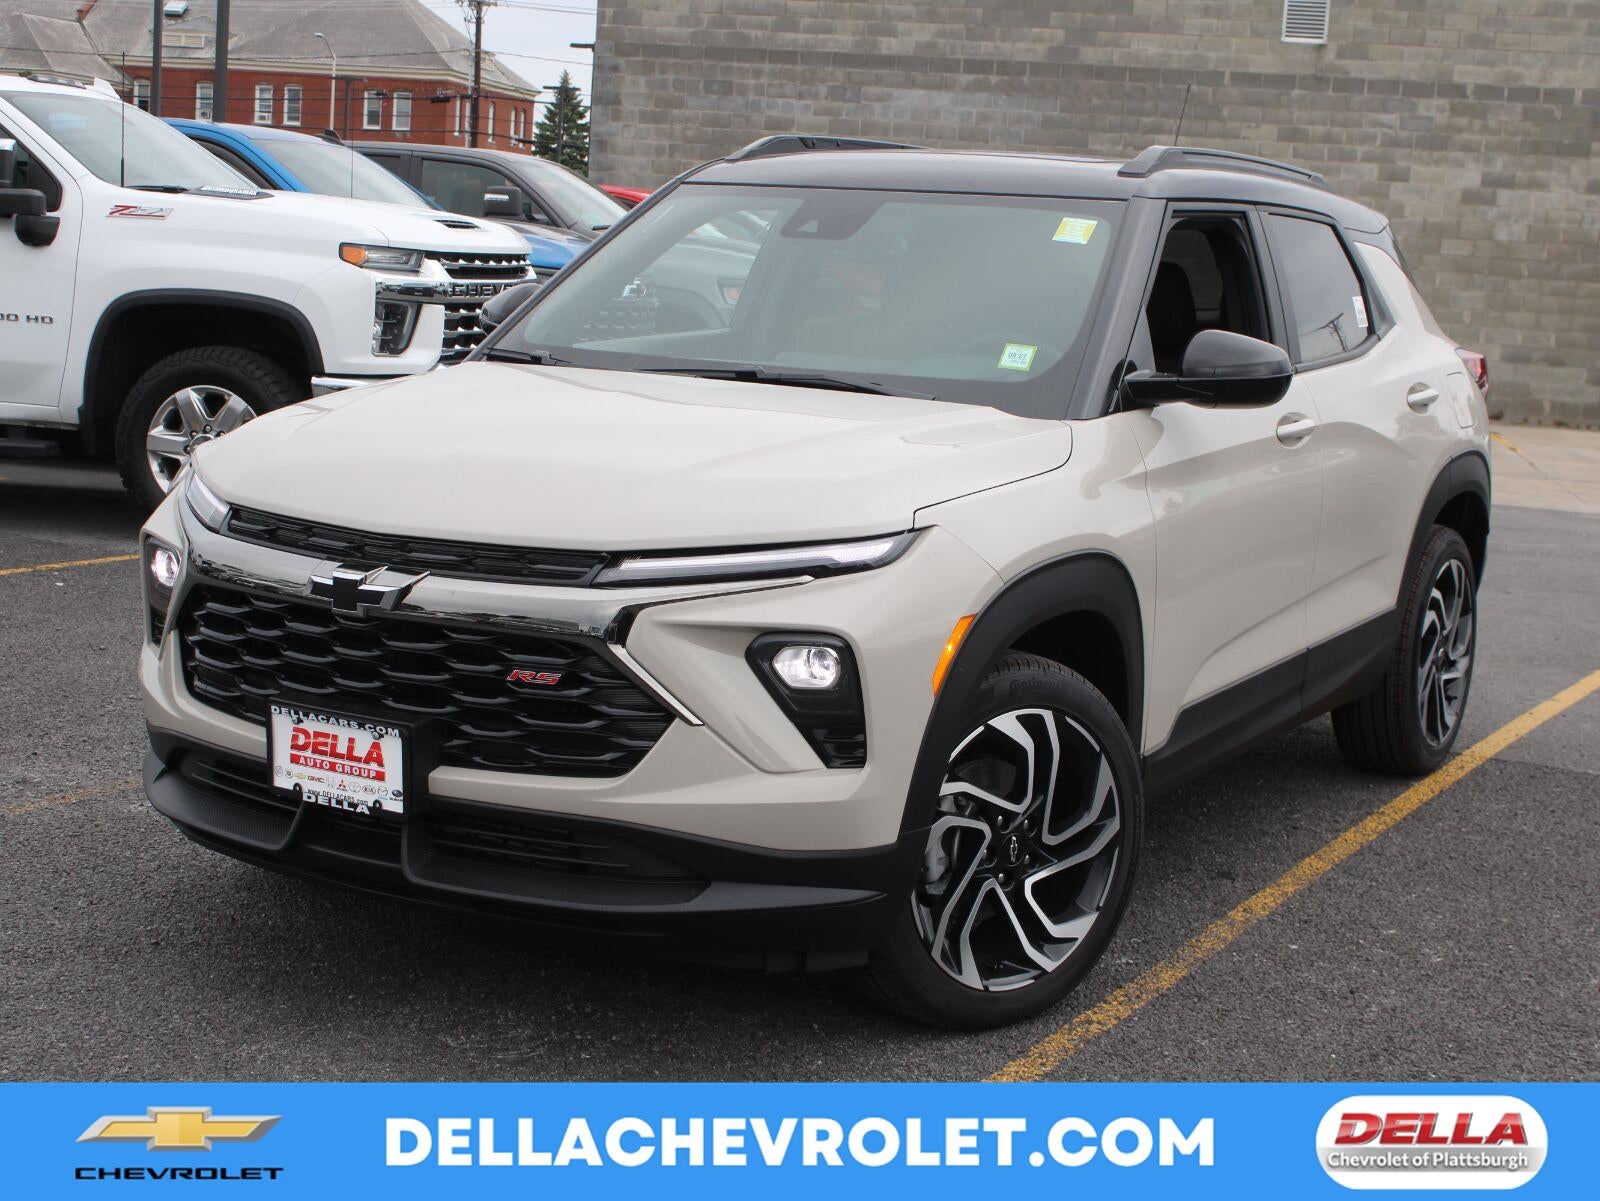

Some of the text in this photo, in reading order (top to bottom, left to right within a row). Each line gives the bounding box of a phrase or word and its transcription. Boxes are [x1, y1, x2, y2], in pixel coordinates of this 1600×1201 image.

[26, 315, 53, 324] HD
[506, 669, 562, 685] RS
[271, 705, 400, 737] DELLACARS.COM
[290, 726, 385, 767] DELLA
[299, 755, 377, 779] AUTO GROUP
[307, 775, 325, 784] GMC
[303, 794, 370, 815] DELLA
